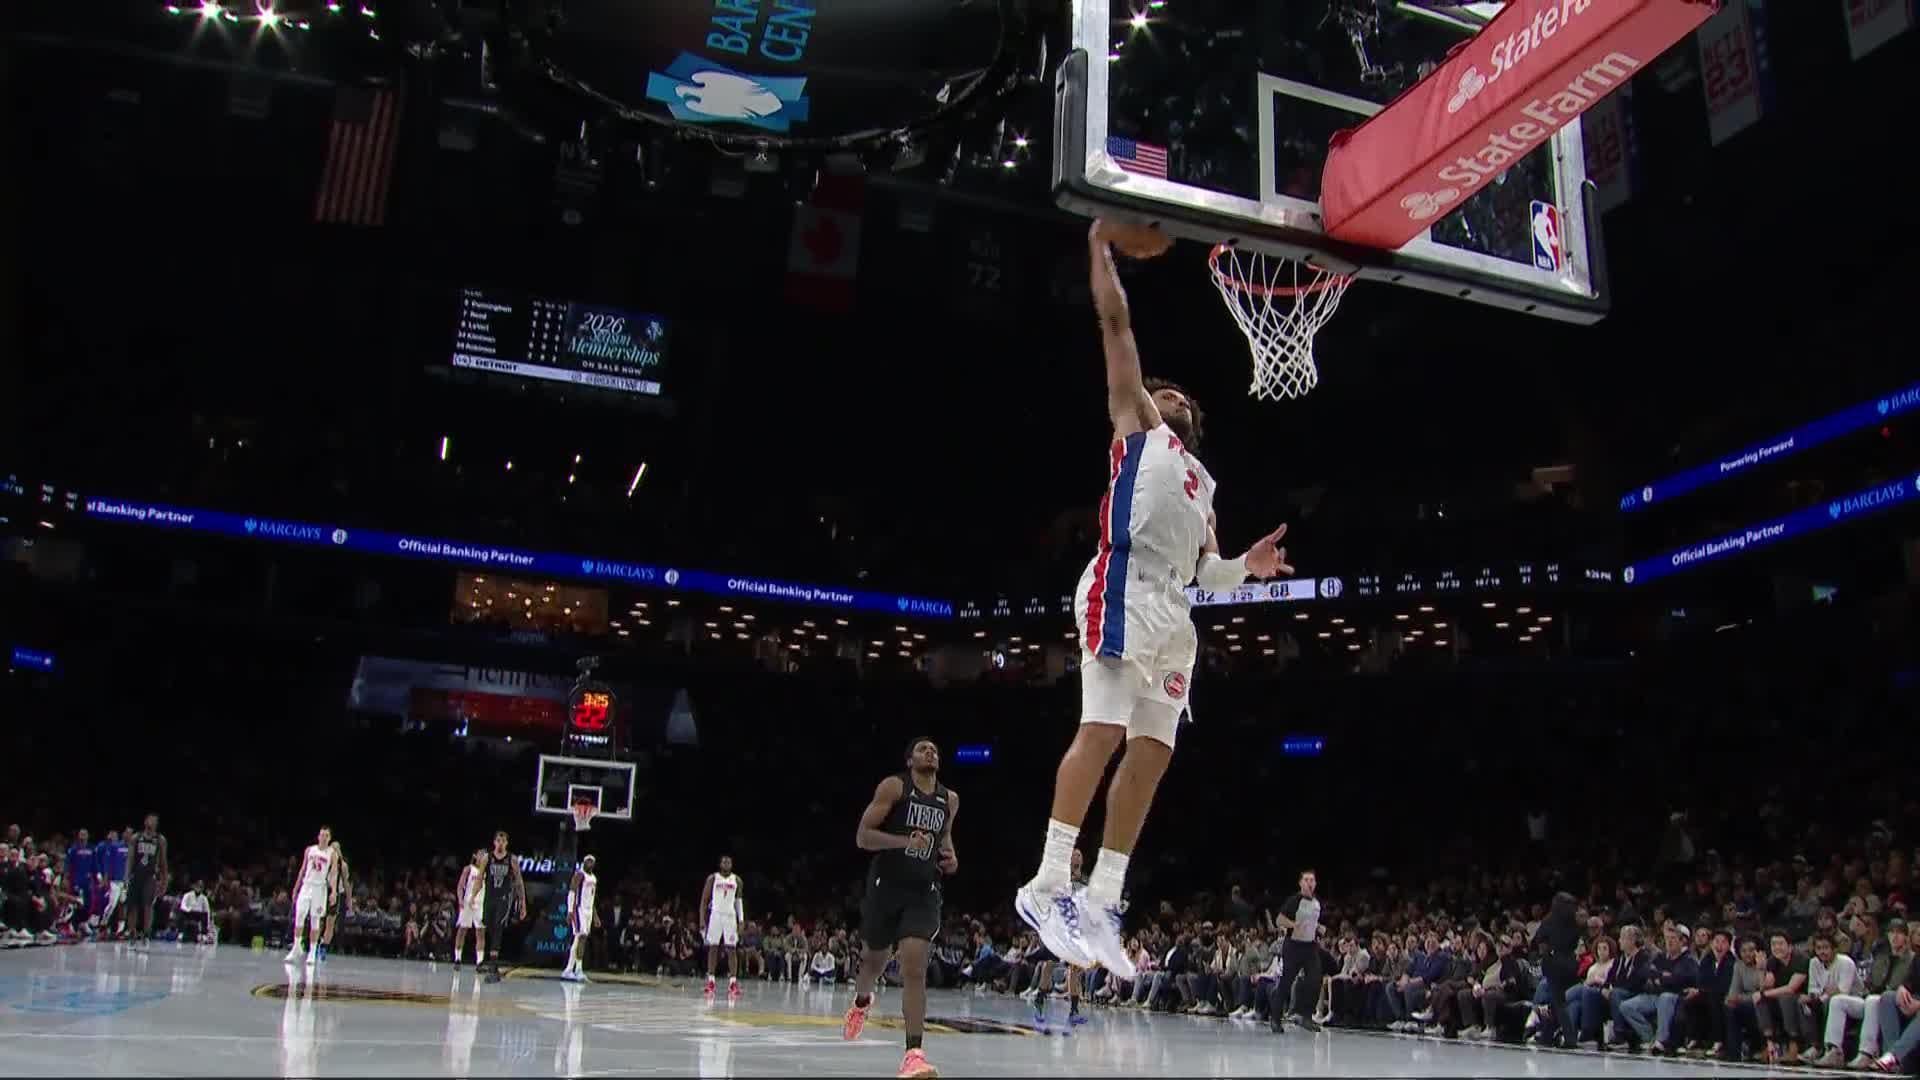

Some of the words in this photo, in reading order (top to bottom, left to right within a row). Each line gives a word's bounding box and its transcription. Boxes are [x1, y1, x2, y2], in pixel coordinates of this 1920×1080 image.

[584, 312, 625, 336] 2026
[568, 336, 661, 368] Memberships
[1720, 451, 1758, 473] Powering
[1759, 435, 1795, 459] Forward
[1184, 469, 1198, 500] 2
[1842, 481, 1905, 513] BARCLAYS
[97, 501, 147, 521] Banking
[148, 507, 194, 524] Partner
[259, 521, 321, 539] BARCLAYS
[398, 538, 442, 555] Official
[442, 543, 490, 563] Banking
[491, 549, 535, 567] Partner
[1672, 544, 1706, 567] Official
[1706, 534, 1745, 557] Banking
[1746, 521, 1785, 543] Partner
[596, 561, 656, 580] BARCLAYS
[728, 578, 768, 594] Official
[769, 582, 812, 600] Banking
[813, 589, 854, 604] Partner
[1195, 589, 1215, 603] 82
[1270, 583, 1290, 598] 68
[576, 705, 608, 729] 22
[907, 801, 945, 833] NETS
